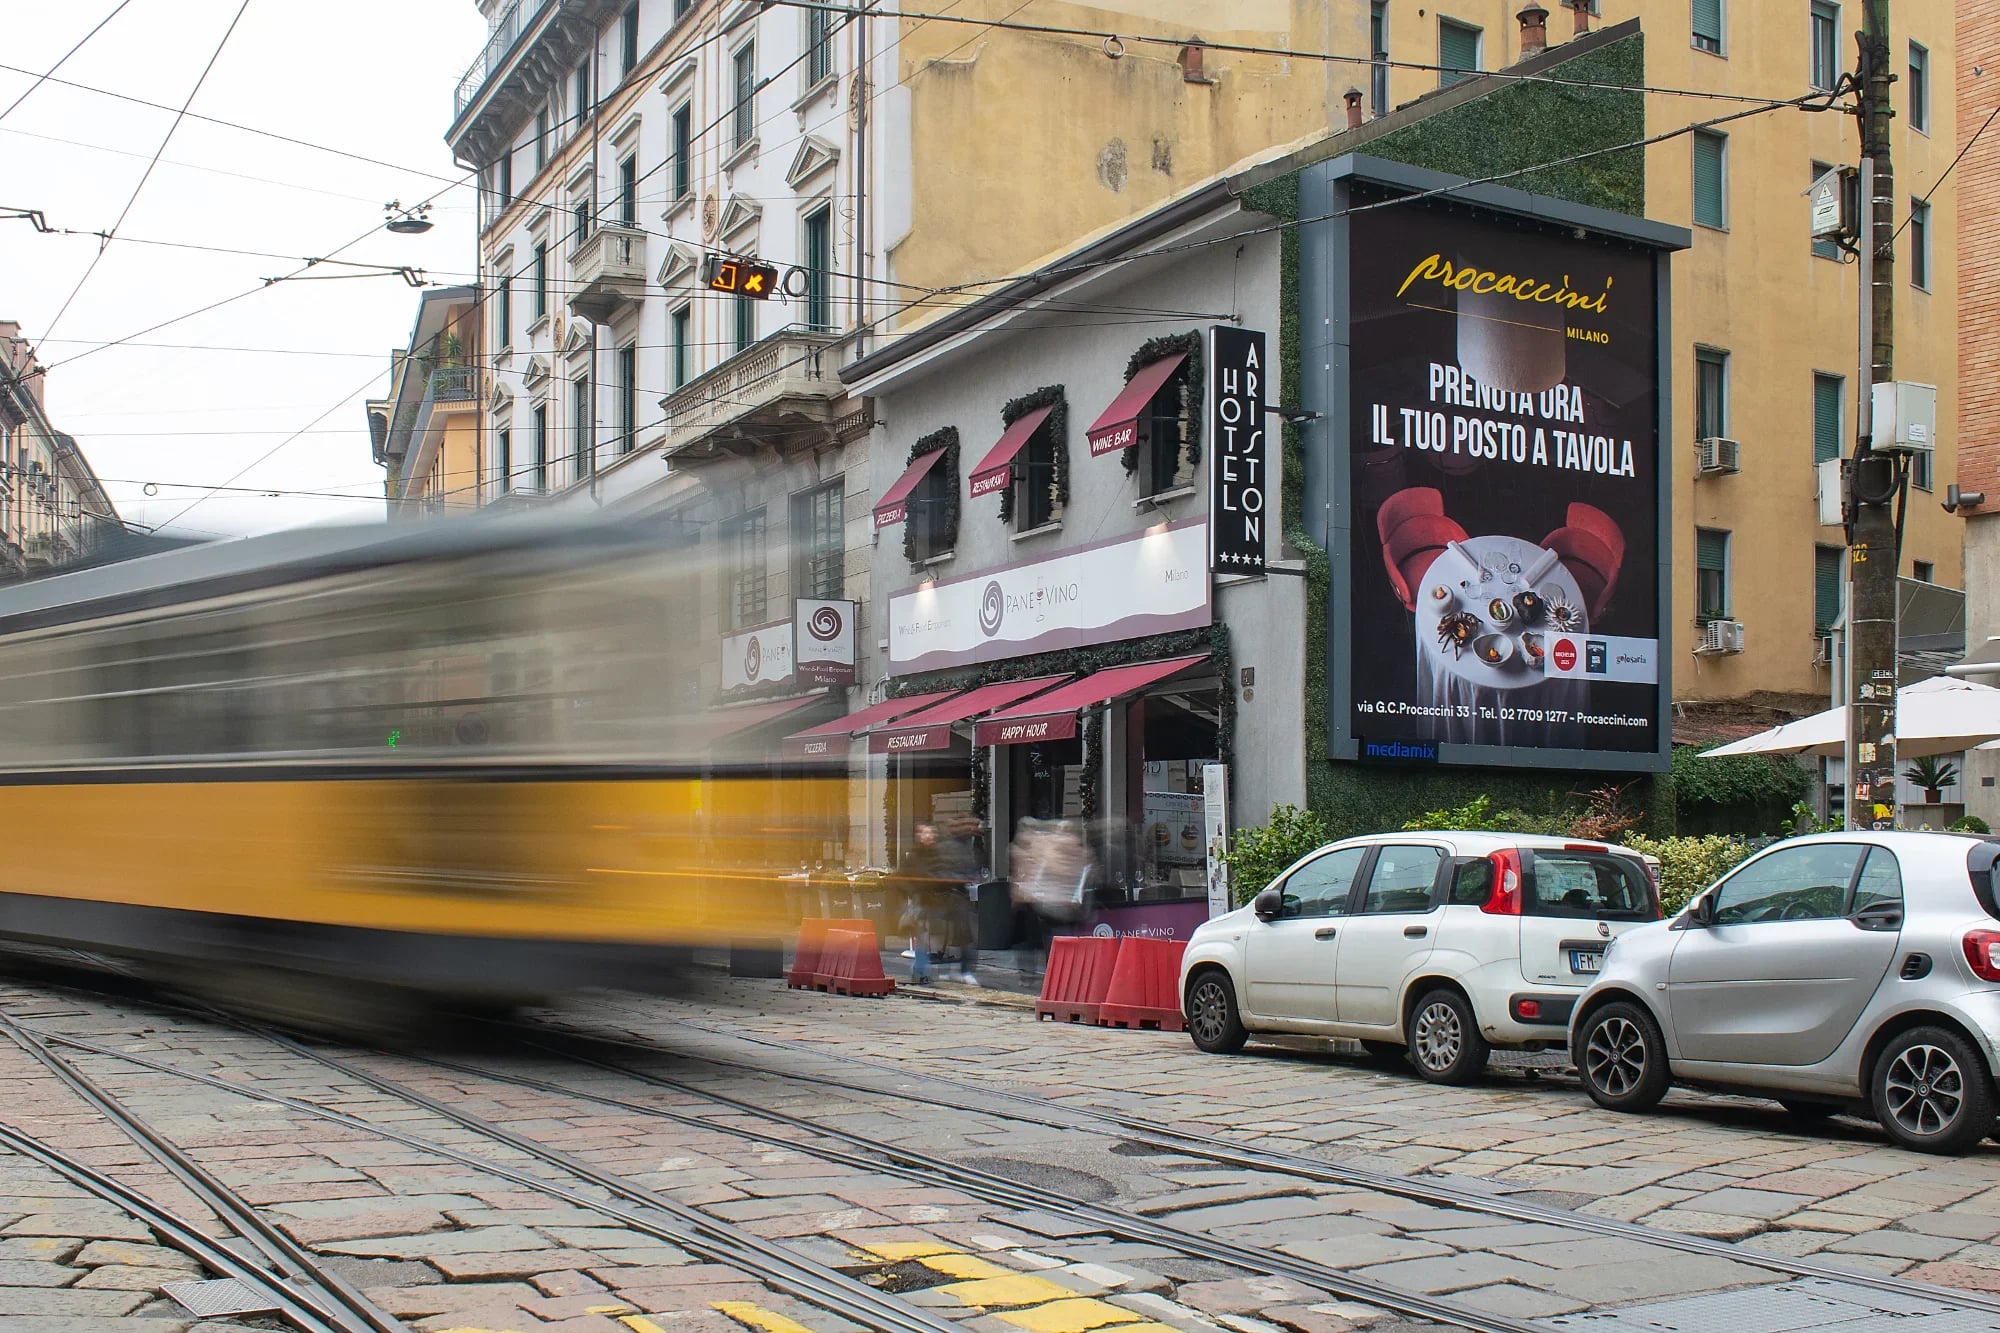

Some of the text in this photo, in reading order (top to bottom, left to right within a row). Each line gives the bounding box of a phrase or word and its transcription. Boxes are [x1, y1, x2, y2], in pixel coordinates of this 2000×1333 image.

[1566, 327, 1609, 344] MILANO
[1540, 383, 1584, 423] ORA
[1092, 428, 1132, 453] WINE BAR
[1220, 367, 1241, 511] HOTEL
[1241, 342, 1262, 543] ARISTON
[1373, 404, 1635, 477] IL TUO POSTO A TAVOLA
[1006, 583, 1078, 614] PANE VINO
[1357, 701, 1373, 713] via
[1456, 706, 1470, 718] 33
[1480, 706, 1498, 719] Tel.
[1500, 708, 1515, 720] 02
[1516, 709, 1543, 722] 7709
[1545, 711, 1568, 723] 1277
[887, 733, 928, 749] RESTAURANT
[1001, 722, 1048, 740] HAPPY HOUR
[804, 742, 827, 754] PIZZERIA
[1366, 742, 1435, 758] mediamix
[1148, 927, 1174, 937] VINO
